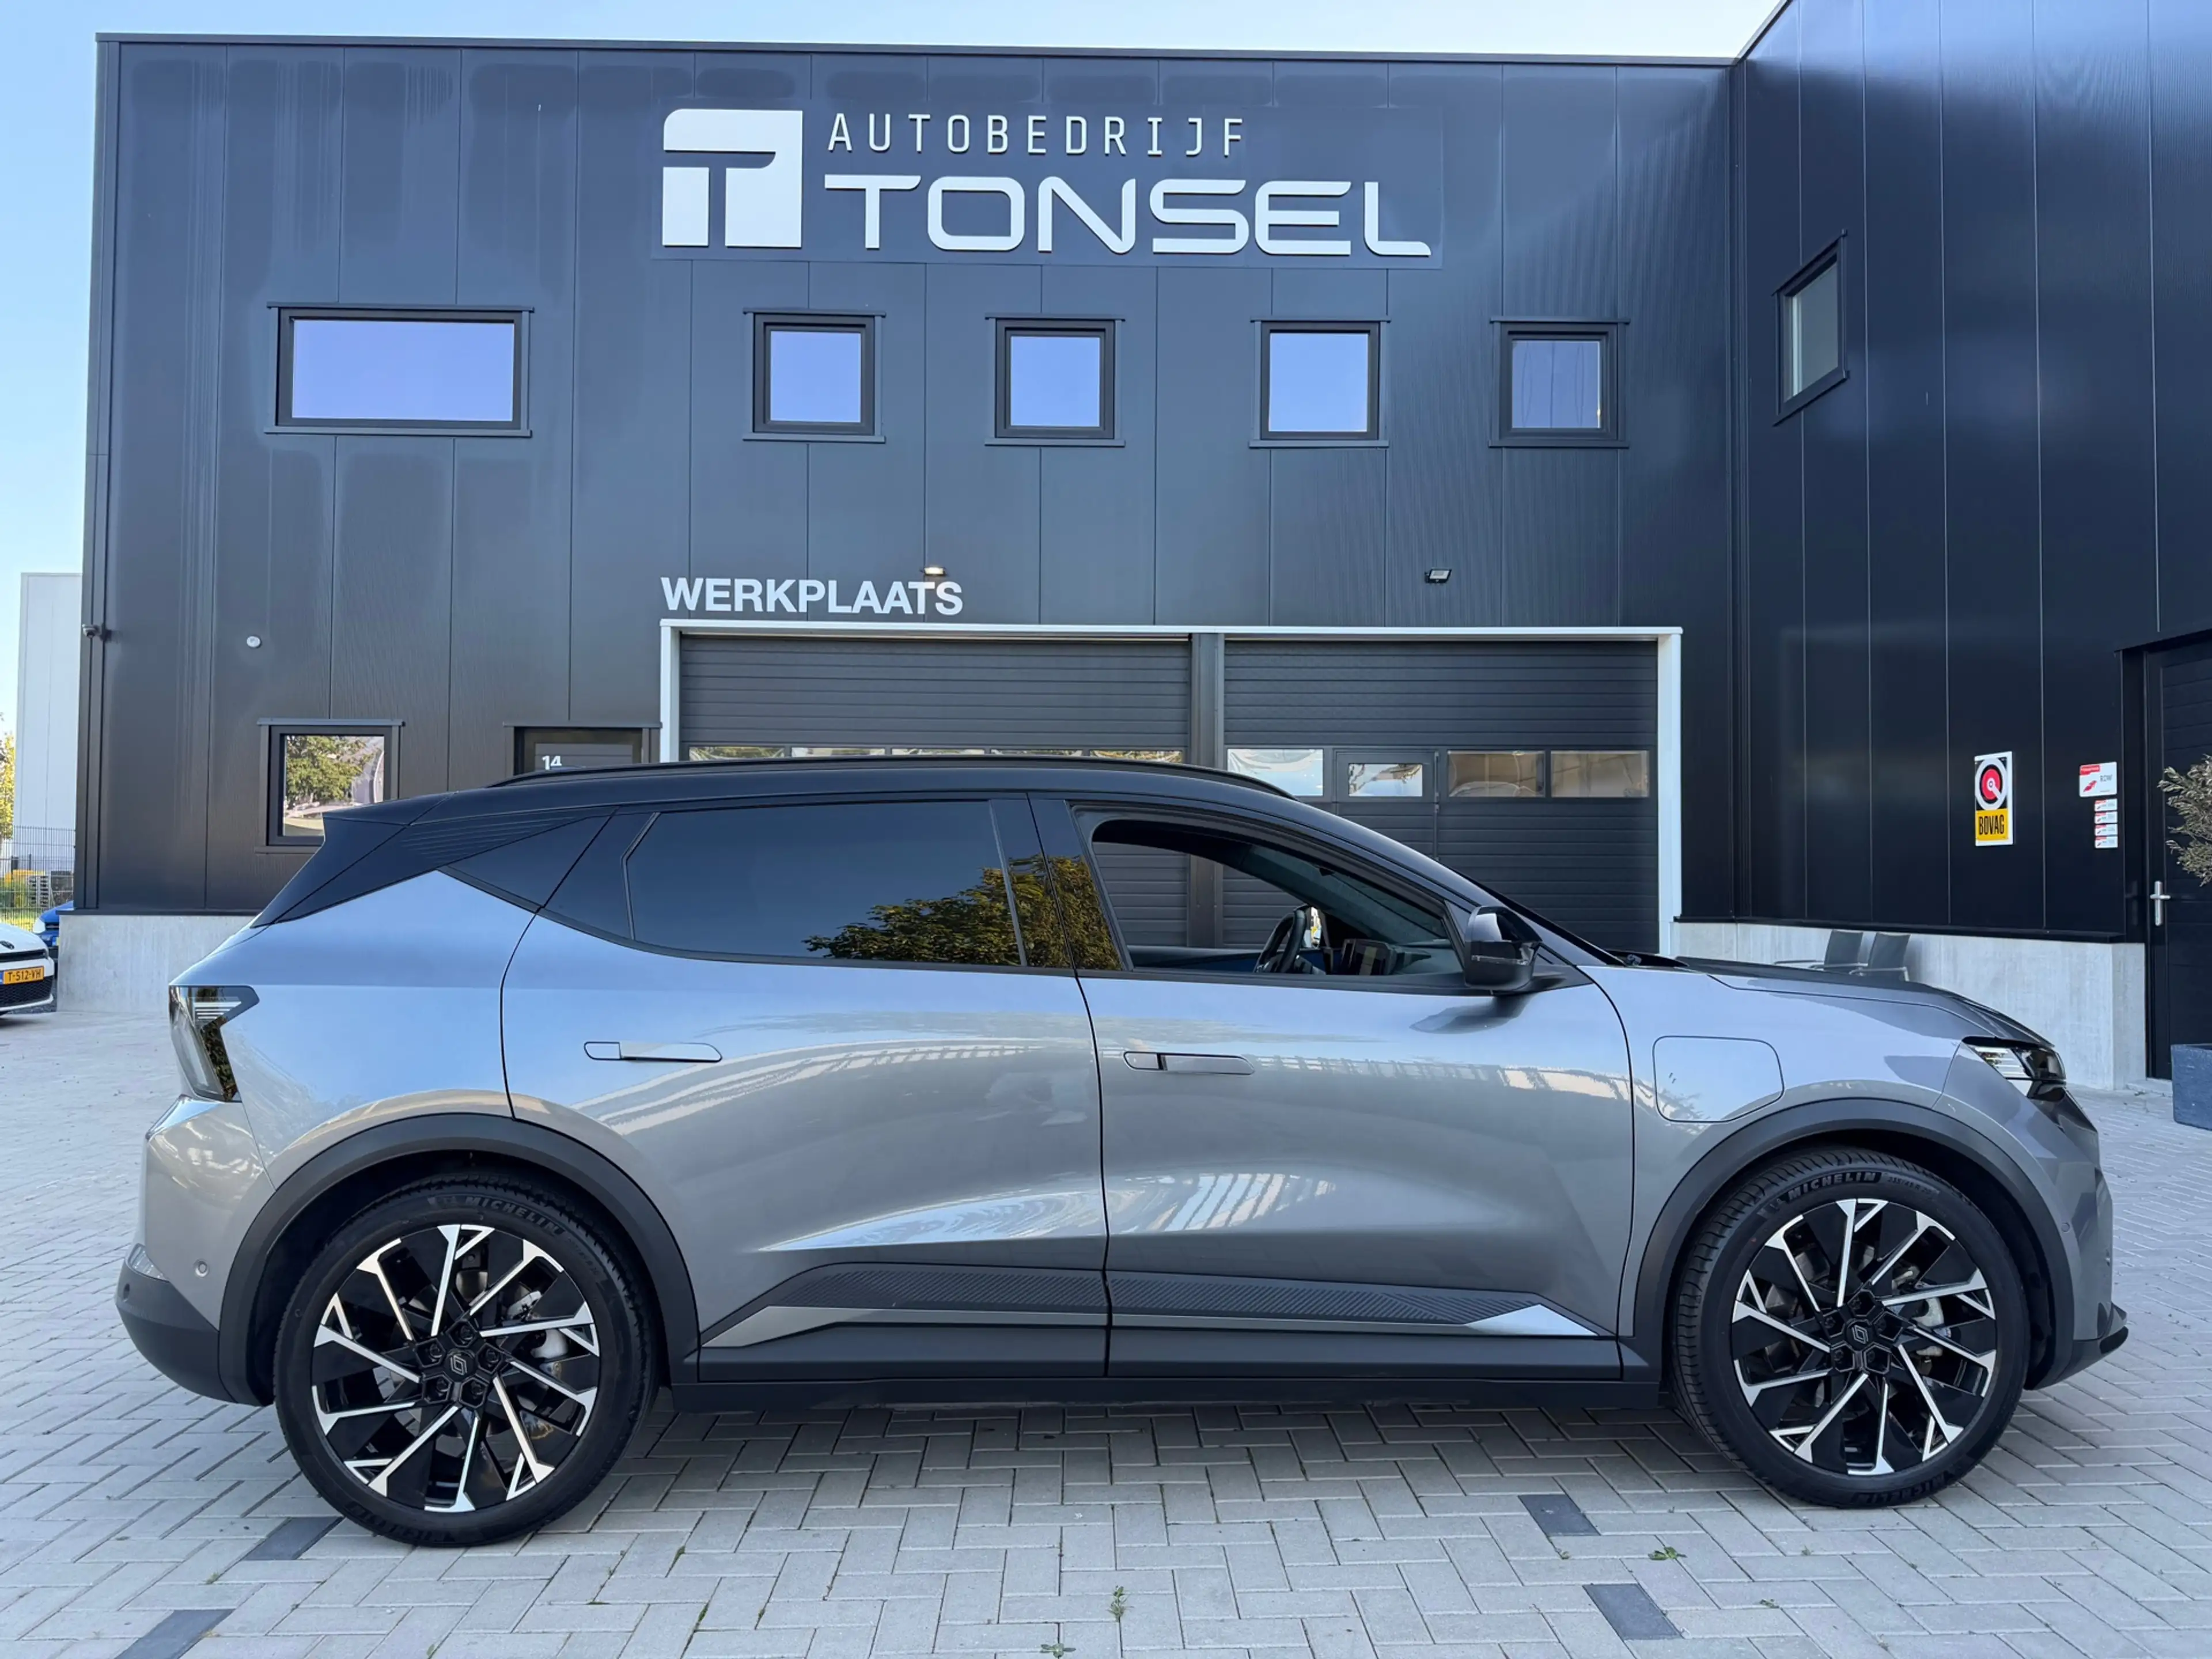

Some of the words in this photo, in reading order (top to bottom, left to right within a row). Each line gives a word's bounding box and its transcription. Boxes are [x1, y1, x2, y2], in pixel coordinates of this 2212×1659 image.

[828, 113, 1243, 156] AUTOBEDRIJF
[824, 174, 1432, 256] TONSEL
[660, 577, 964, 615] WERKPLAATS
[541, 755, 562, 770] 14
[1979, 815, 2005, 835] BOVAG
[8, 968, 41, 982] T-512-VH
[1787, 1172, 1877, 1200] MICHELIN
[464, 1196, 562, 1235] MICHELIN
